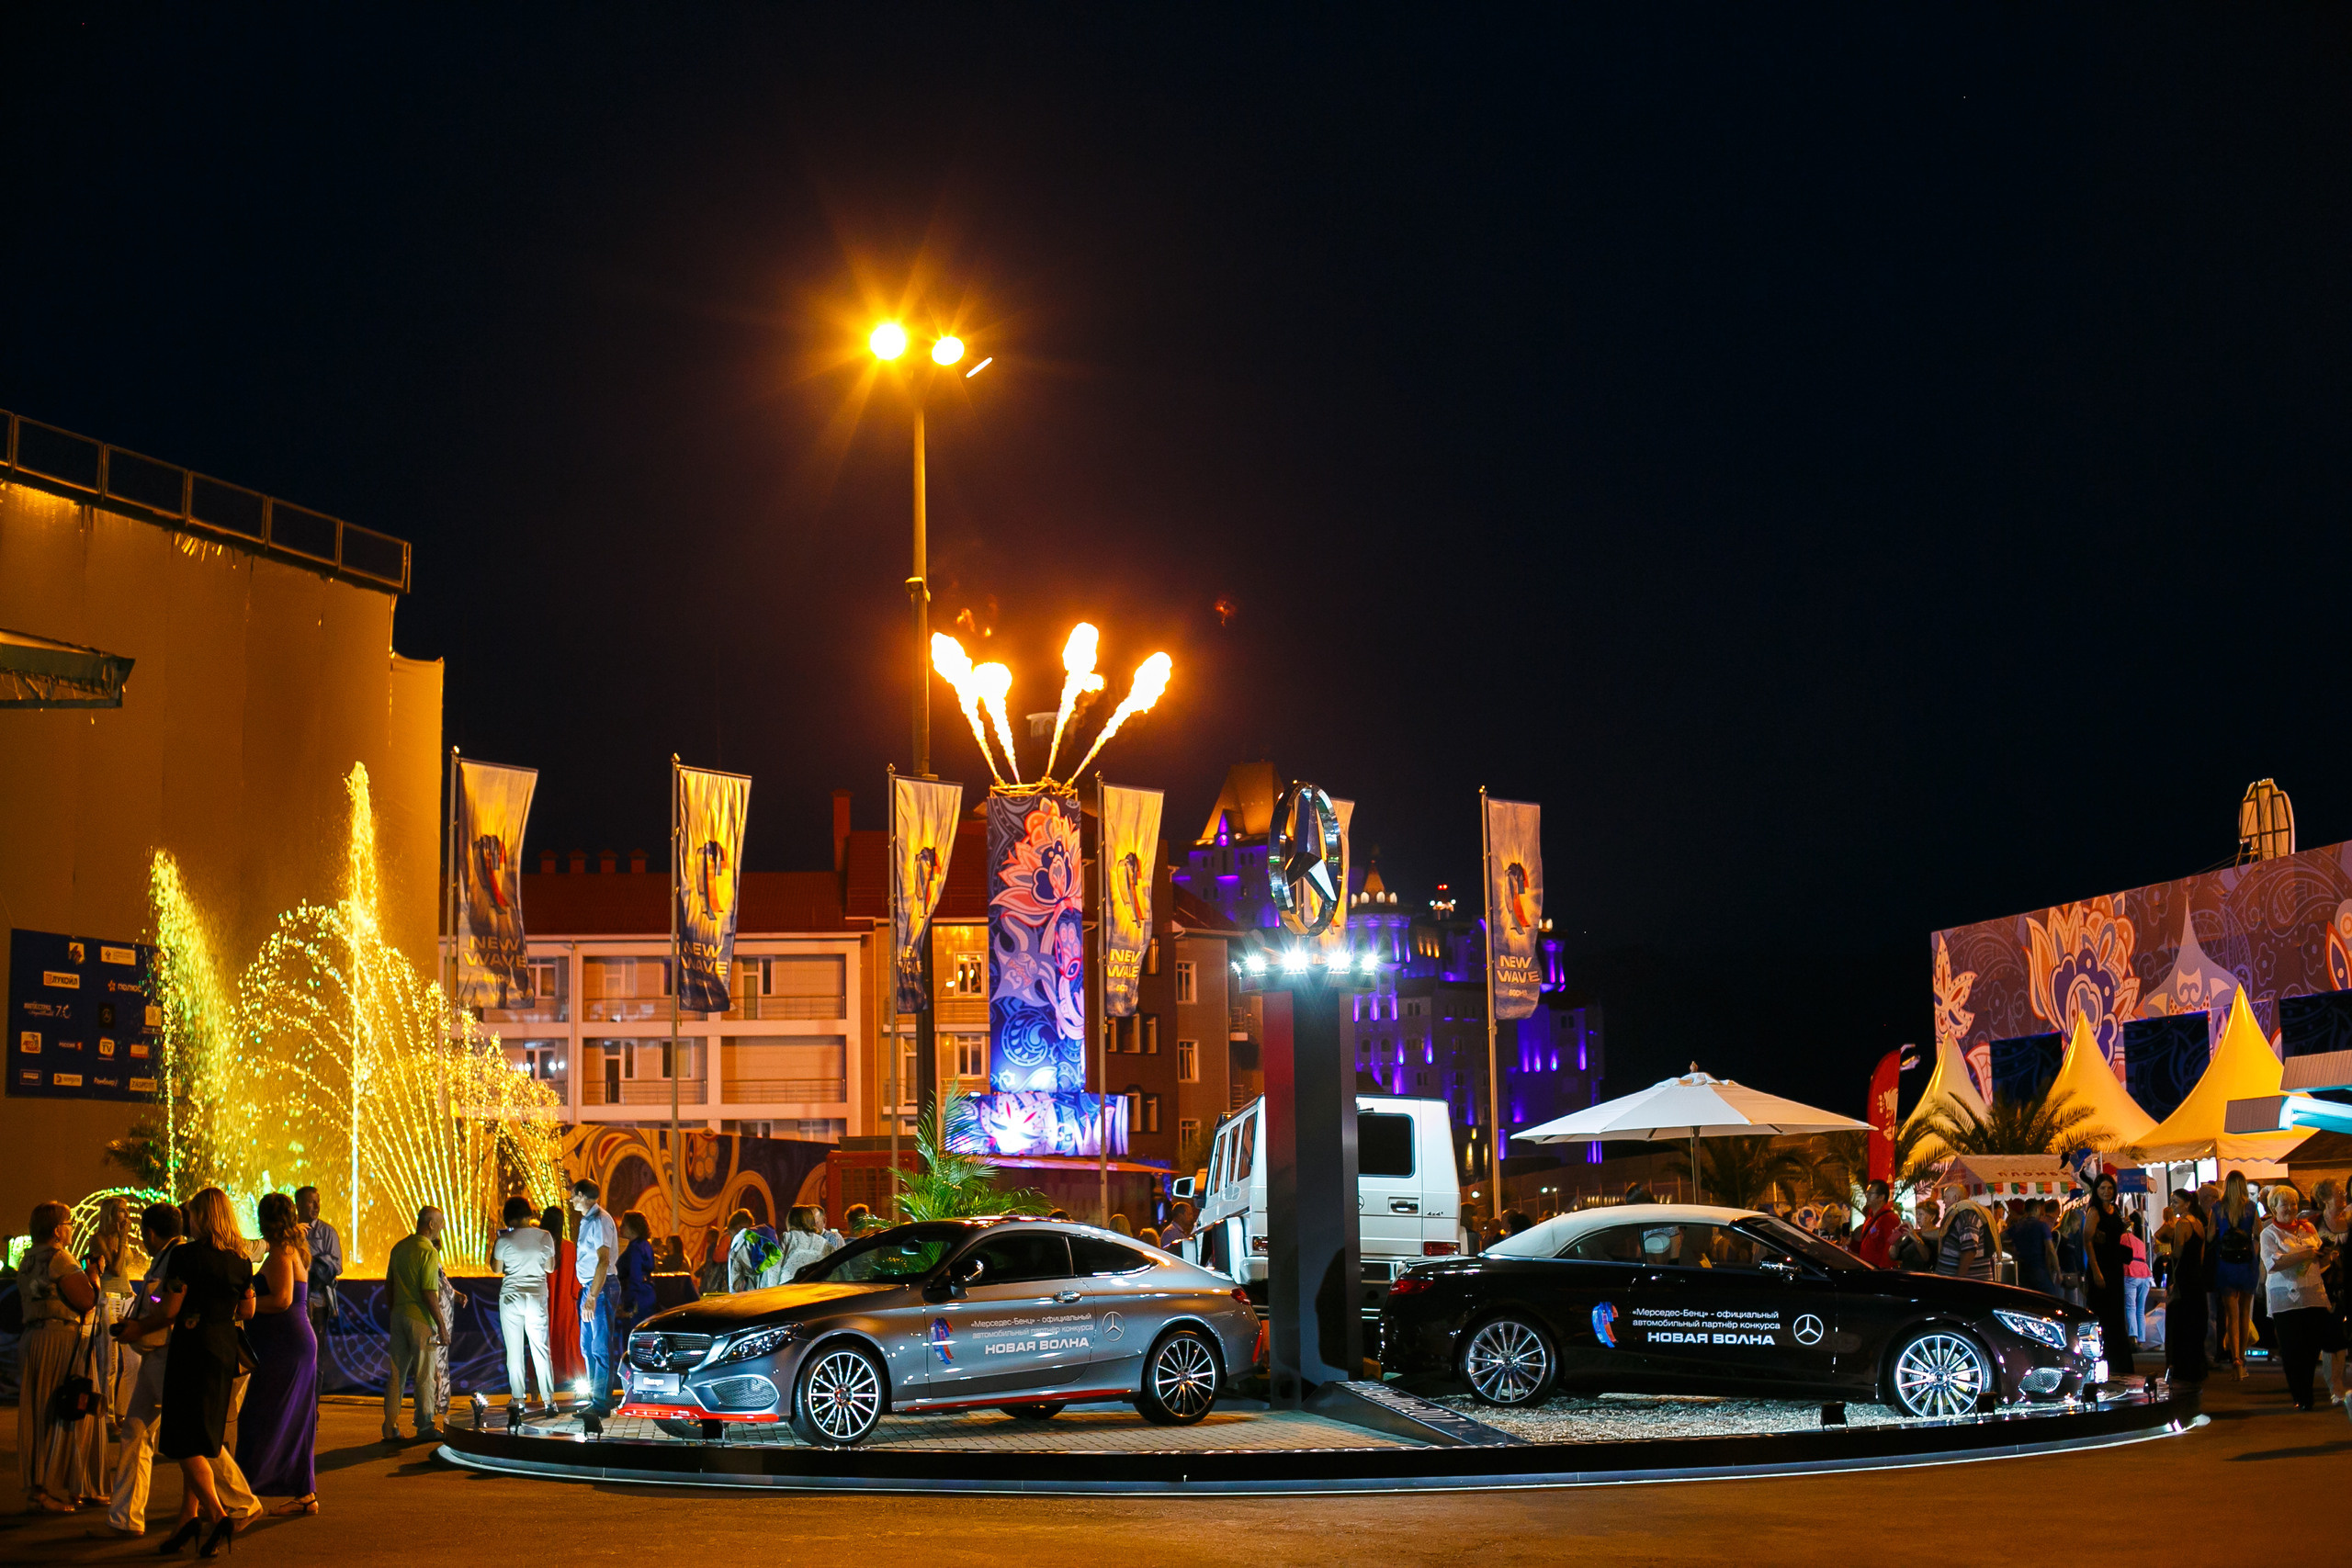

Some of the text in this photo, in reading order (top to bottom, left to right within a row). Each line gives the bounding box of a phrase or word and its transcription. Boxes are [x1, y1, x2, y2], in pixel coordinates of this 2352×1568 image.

[469, 935, 520, 952] NEW
[684, 941, 723, 958] NEW
[463, 952, 526, 968] WAVE
[681, 955, 729, 976] WAVE
[1499, 954, 1532, 969] NEW
[1497, 969, 1541, 984] WAVE
[970, 1317, 1035, 1328] «Мерседес-Бенц»
[1041, 1312, 1091, 1324] официальный
[1632, 1307, 1709, 1318] «Мерседес-Бенц»
[1716, 1310, 1779, 1320] официальный
[972, 1327, 1030, 1339] автомобильный
[1061, 1324, 1093, 1333] конкурса
[1633, 1318, 1781, 1330] автомобильный партнёр конкурса
[985, 1337, 1090, 1355] НОВАЯ ВОЛНА
[1647, 1331, 1776, 1346] НОВАЯ ВОЛНА
